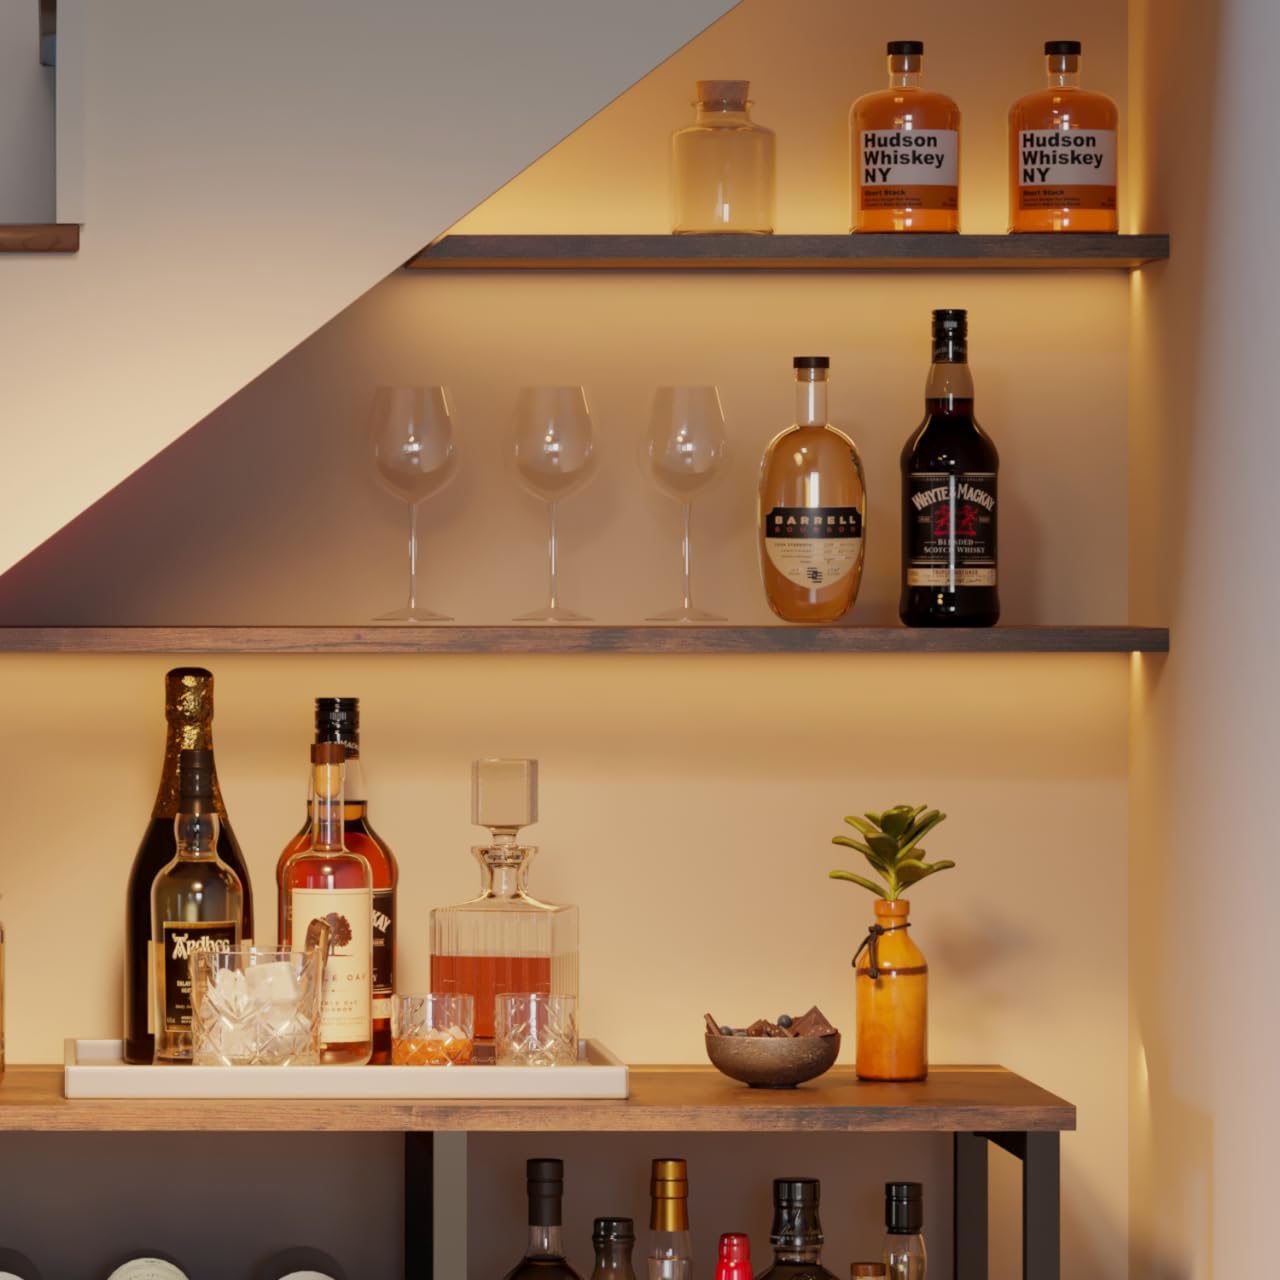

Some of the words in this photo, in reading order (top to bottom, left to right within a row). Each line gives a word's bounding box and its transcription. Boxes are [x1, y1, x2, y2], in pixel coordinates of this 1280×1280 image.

[864, 133, 937, 148] Hudson
[1022, 133, 1096, 148] Hudson
[864, 150, 945, 168] Whiskey
[1022, 150, 1103, 168] Whiskey
[864, 168, 891, 183] NY
[1022, 168, 1050, 183] NY
[911, 486, 949, 511] WHYTE
[957, 483, 995, 512] MACKAY
[774, 515, 857, 525] BARRELL
